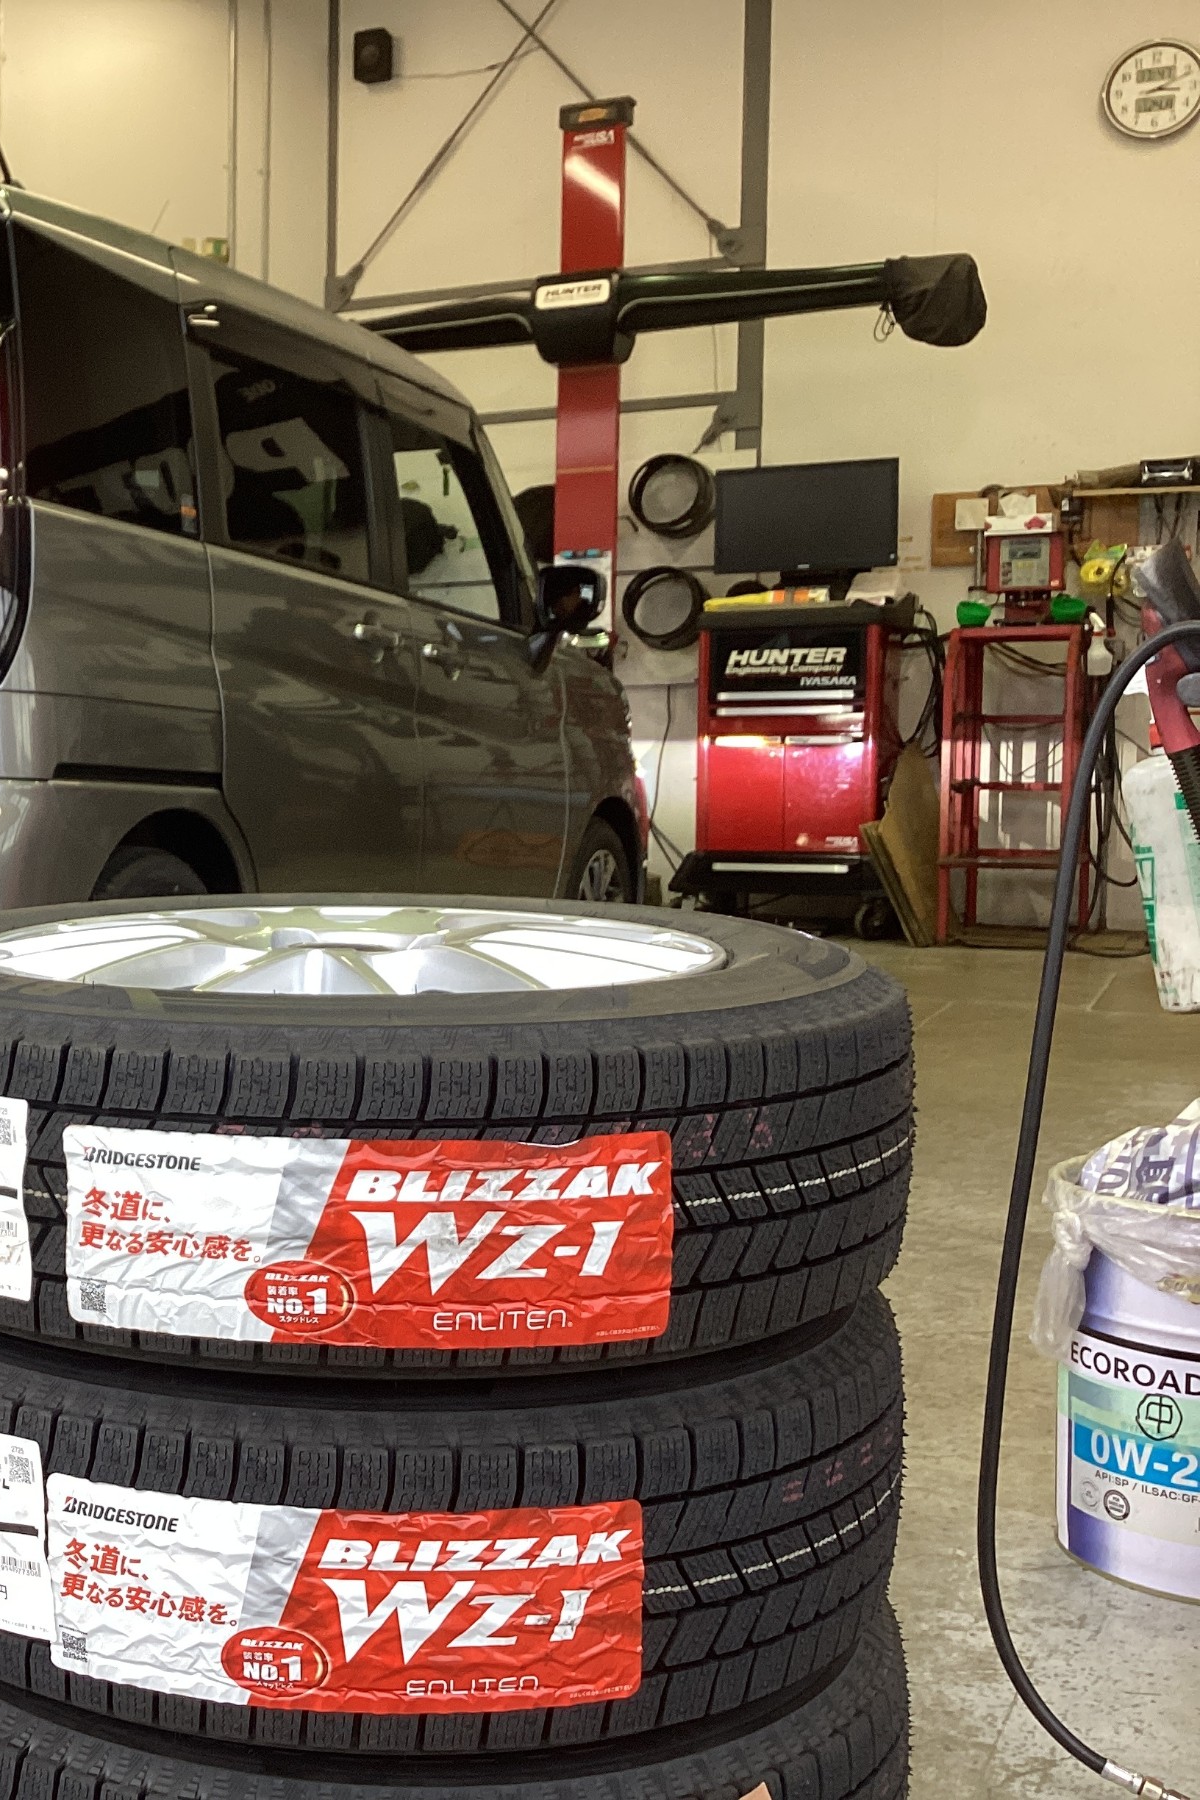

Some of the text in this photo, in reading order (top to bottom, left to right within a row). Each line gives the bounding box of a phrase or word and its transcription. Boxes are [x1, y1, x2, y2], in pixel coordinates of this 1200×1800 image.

[727, 647, 847, 666] HUNTER
[725, 664, 843, 676] Engineering Company
[83, 1146, 202, 1171] BRIDGESTONE
[345, 1161, 663, 1203] BLIZZAK
[81, 1187, 171, 1223] 冬道に、
[78, 1222, 262, 1263] 更なる安心感を。
[265, 1272, 330, 1283] BLIZZAK
[267, 1285, 298, 1296] 装着率
[279, 1315, 319, 1324] スタッドレス
[433, 1310, 568, 1331] ENLITEN
[1071, 1341, 1200, 1396] ECOROAD
[63, 1496, 179, 1532] BRIDGESTONE
[63, 1537, 149, 1580] 冬道に、
[317, 1529, 632, 1572] BLIZZAK
[60, 1572, 237, 1627] 更なる安心感を。
[240, 1638, 304, 1651] BLIZZAK
[406, 1675, 539, 1697] ENLITEN
